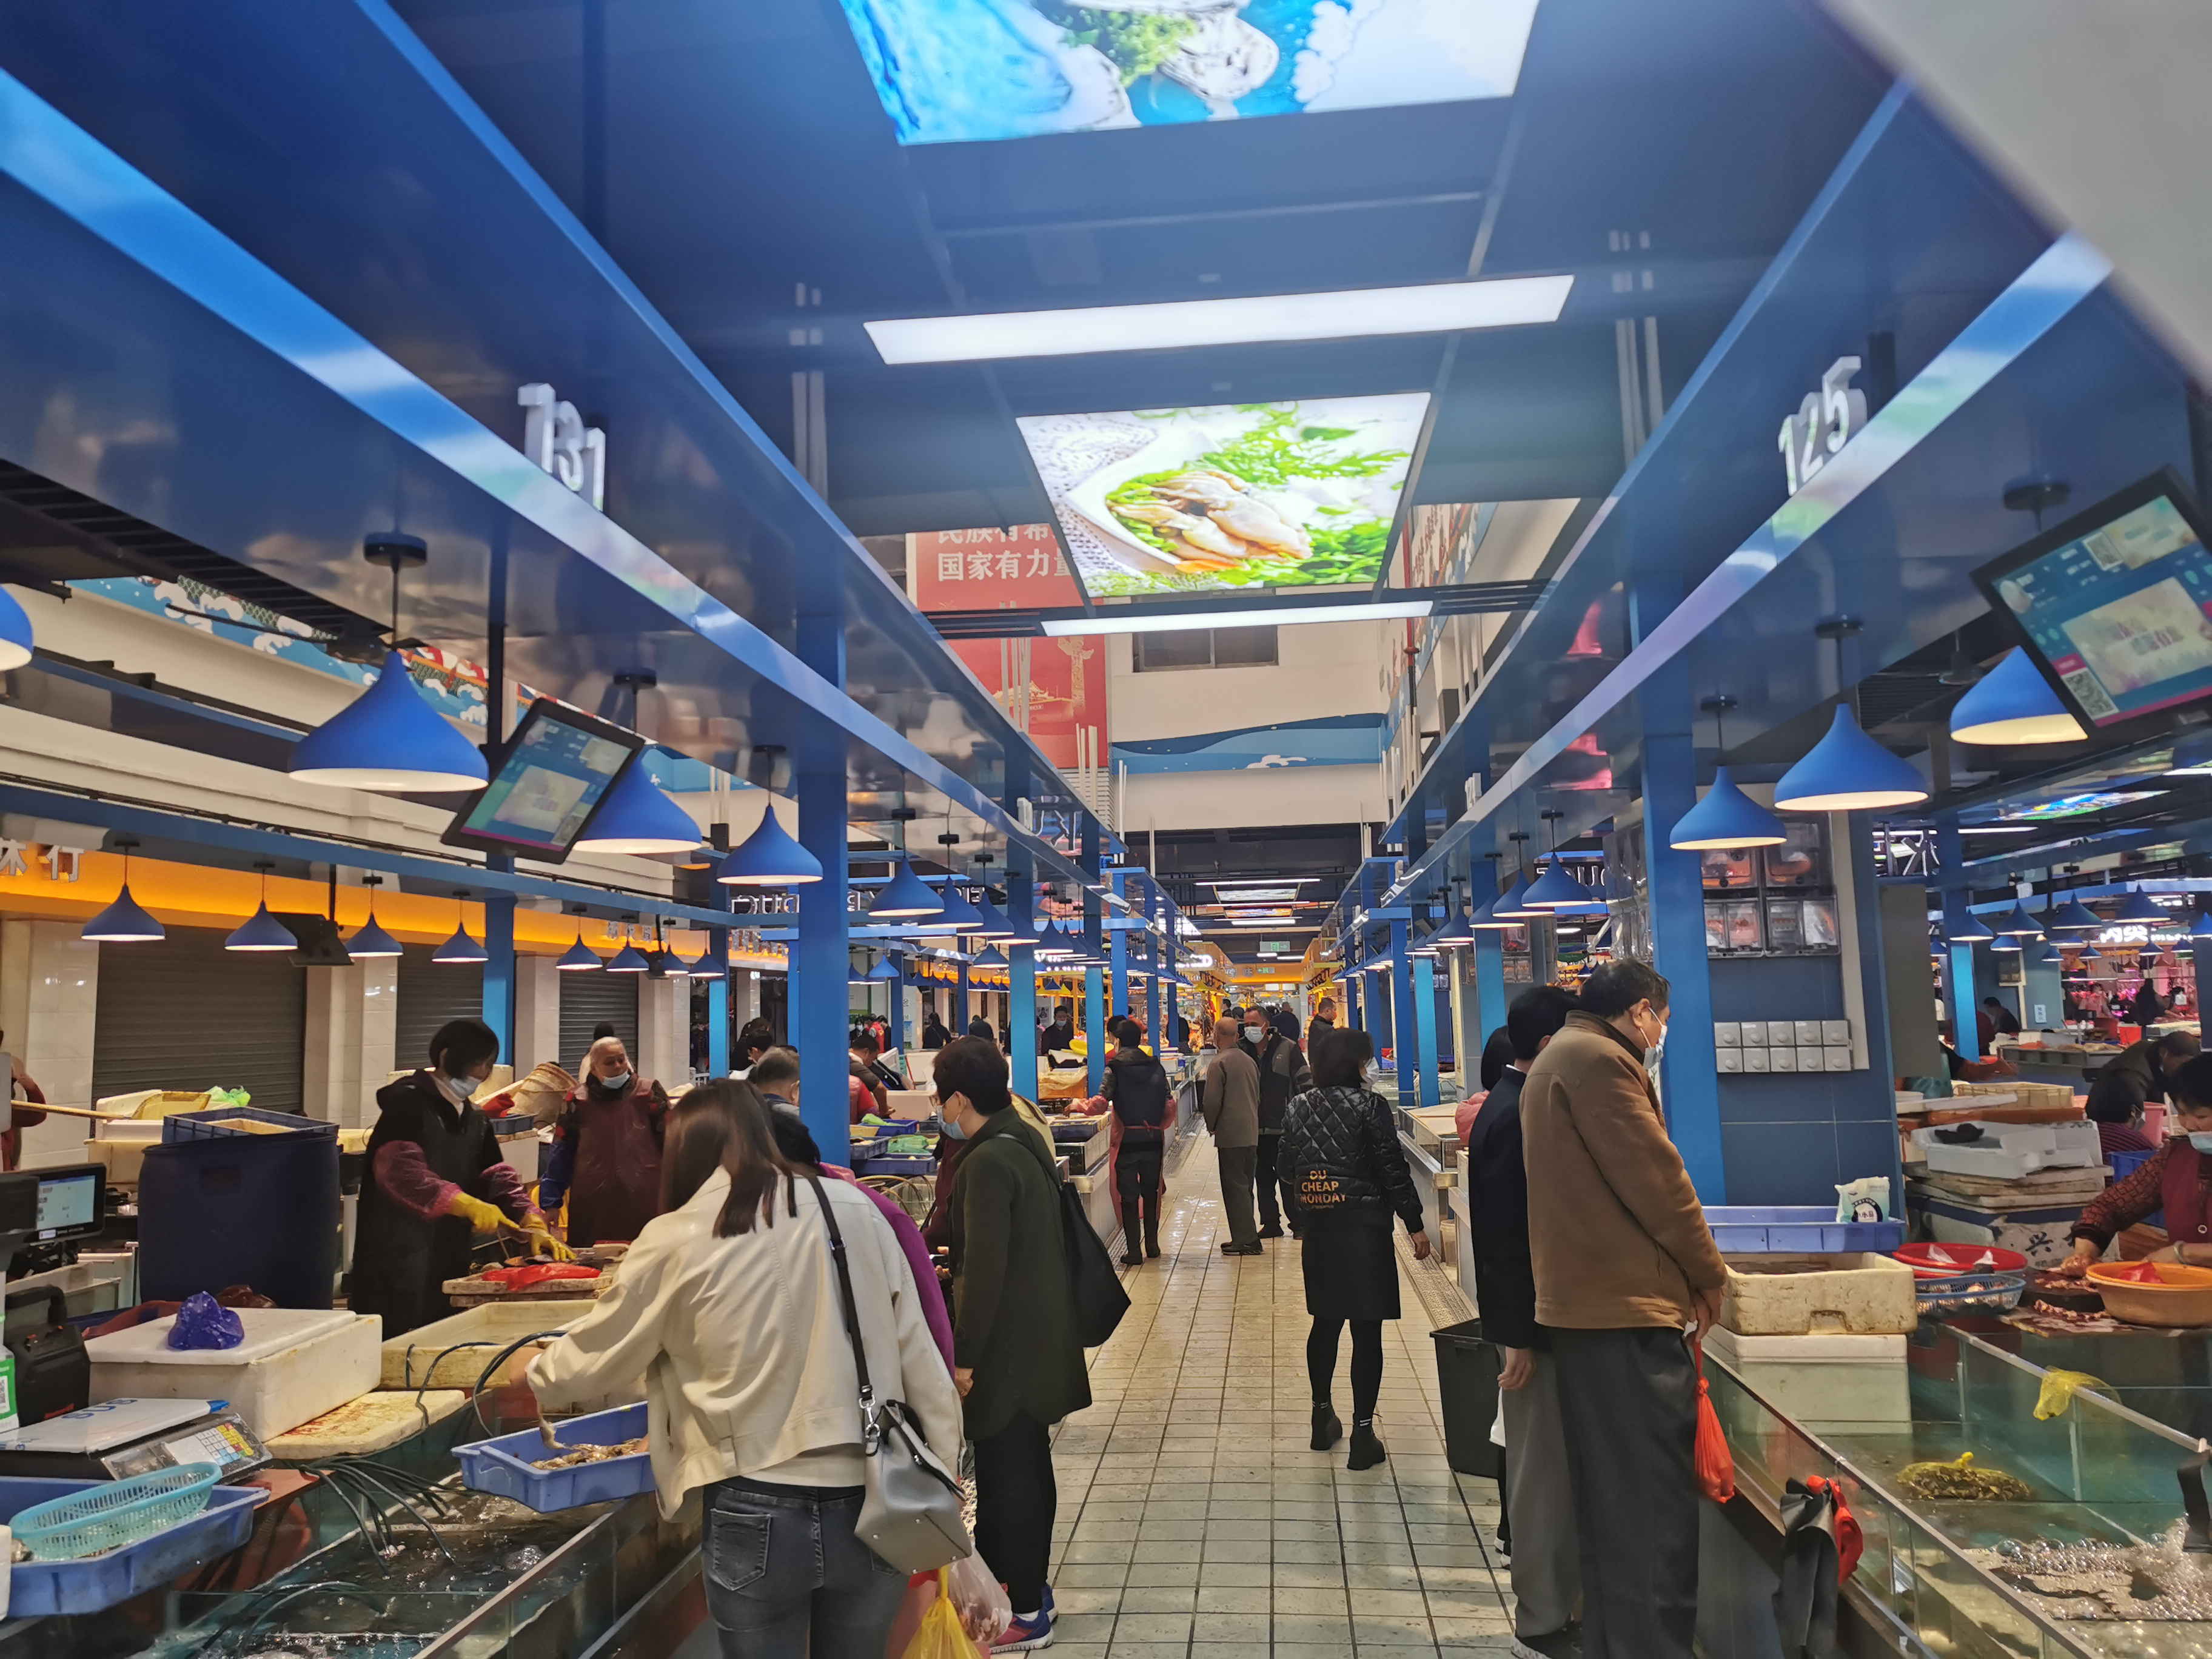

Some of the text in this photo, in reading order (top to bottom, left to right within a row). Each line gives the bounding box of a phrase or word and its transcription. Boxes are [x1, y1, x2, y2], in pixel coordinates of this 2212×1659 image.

[518, 383, 606, 511] 131
[1778, 355, 1868, 496] 125
[1301, 1181, 1339, 1192] CHEAP
